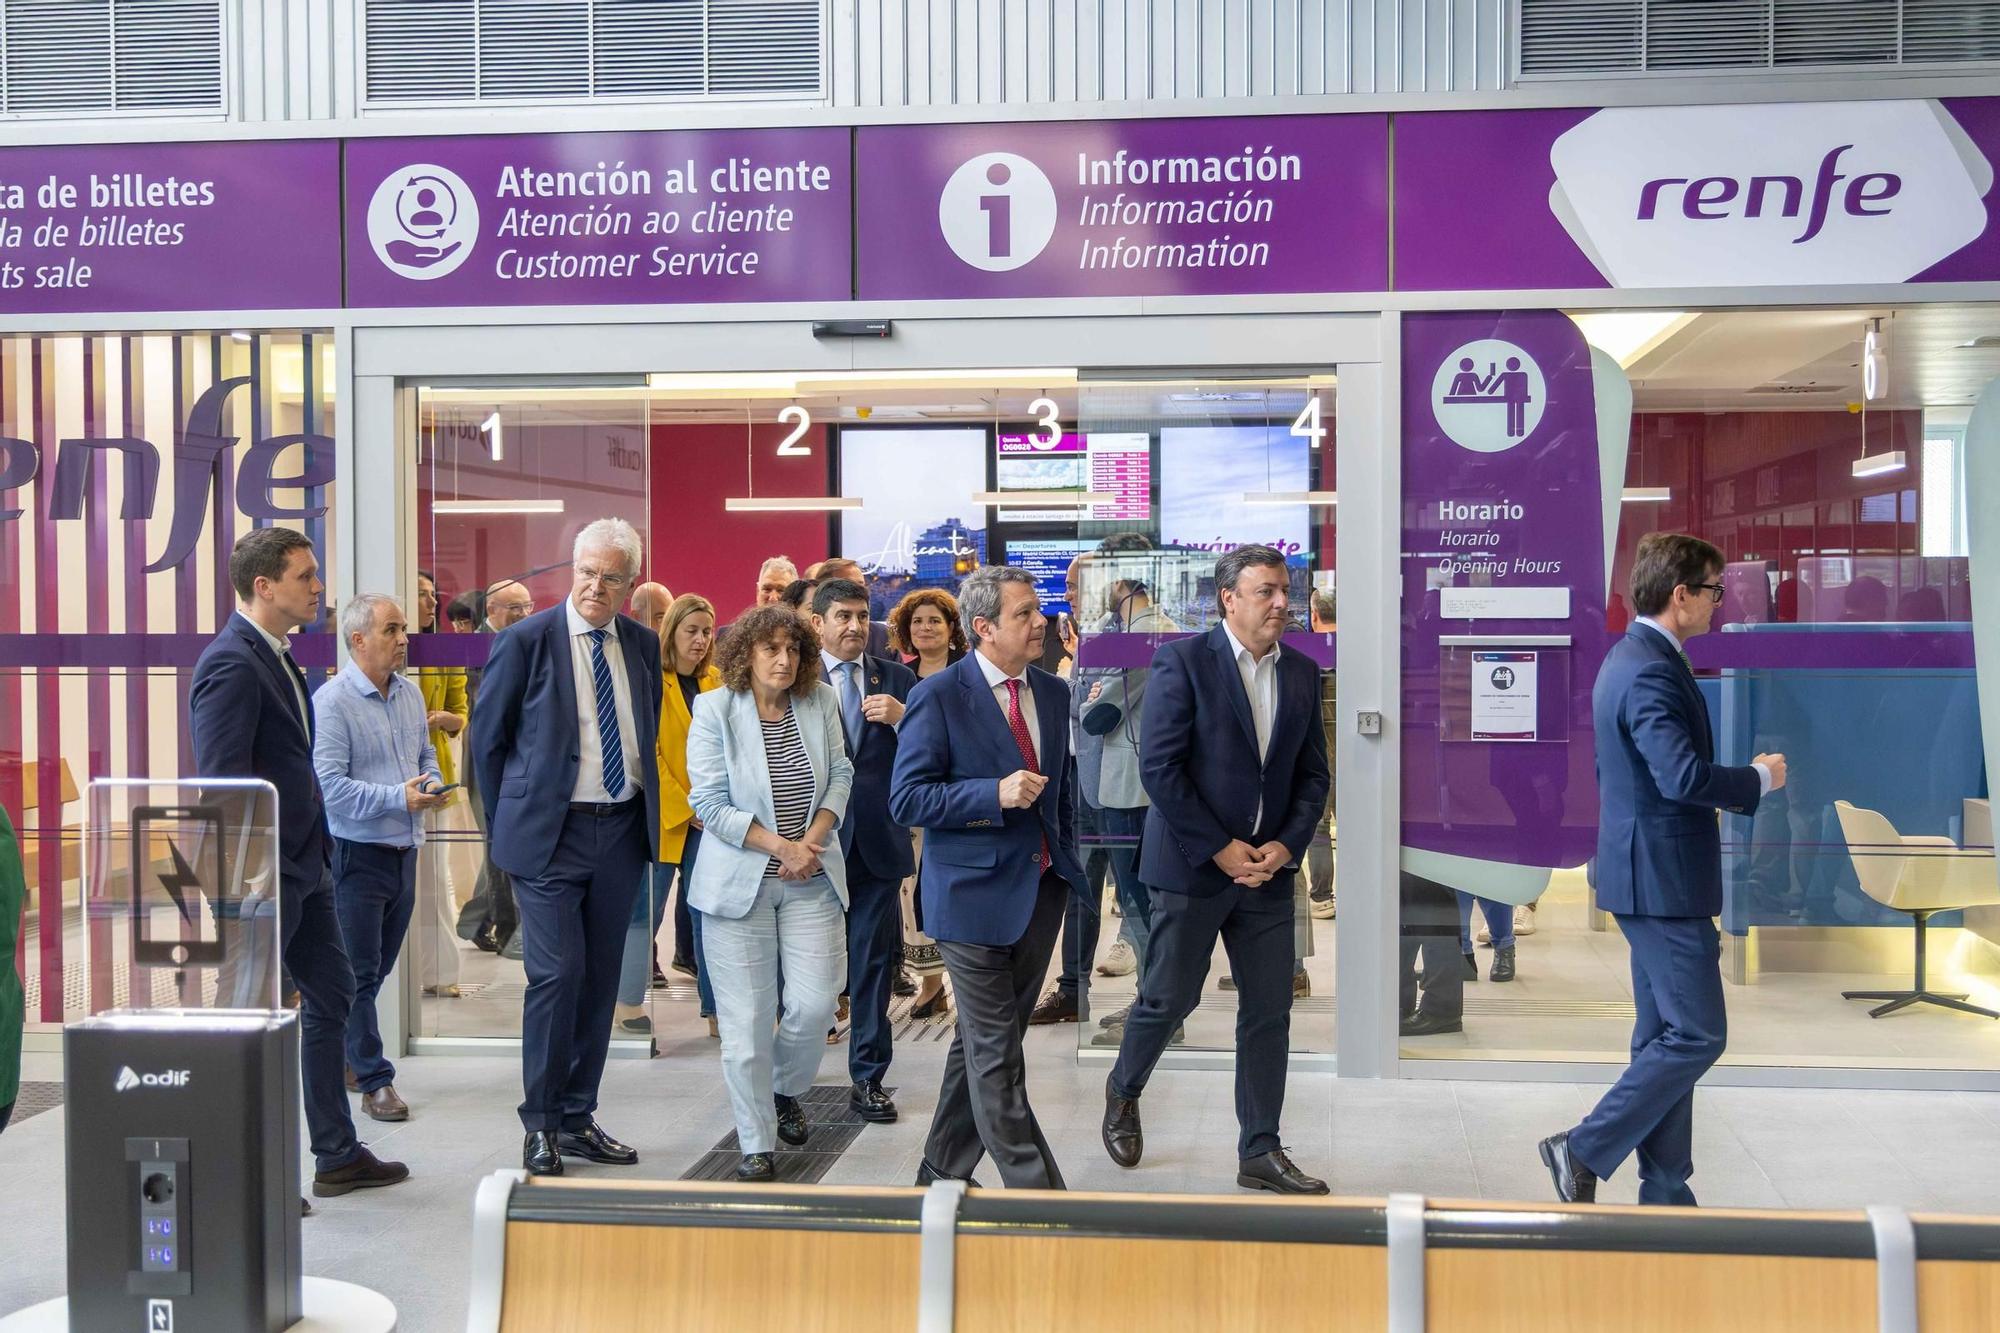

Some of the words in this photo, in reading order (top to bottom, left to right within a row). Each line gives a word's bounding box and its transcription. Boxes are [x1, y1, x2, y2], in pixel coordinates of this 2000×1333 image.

[497, 161, 650, 198] Atención
[665, 160, 698, 194] al
[710, 157, 831, 193] cliente
[1079, 146, 1300, 185] Información
[37, 176, 78, 209] de
[90, 173, 215, 208] billetes
[1080, 190, 1272, 227] Información
[1637, 144, 1901, 244] renfe
[33, 217, 69, 248] de
[79, 215, 185, 247] billetes
[497, 204, 632, 237] Atención
[642, 211, 680, 234] ao
[691, 201, 794, 234] cliente
[495, 249, 641, 279] Customer
[648, 245, 759, 277] Service
[1080, 236, 1268, 270] Information
[33, 257, 92, 288] sale
[481, 412, 503, 461] 1
[776, 405, 812, 457] 2
[1027, 398, 1061, 450] 3
[1290, 398, 1326, 448] 4
[1439, 500, 1524, 521] Horario
[857, 520, 974, 575] Alicante
[1439, 530, 1500, 546] Horario
[1439, 558, 1508, 577] Opening
[1513, 558, 1561, 573] Hours
[142, 1070, 191, 1086] adif
